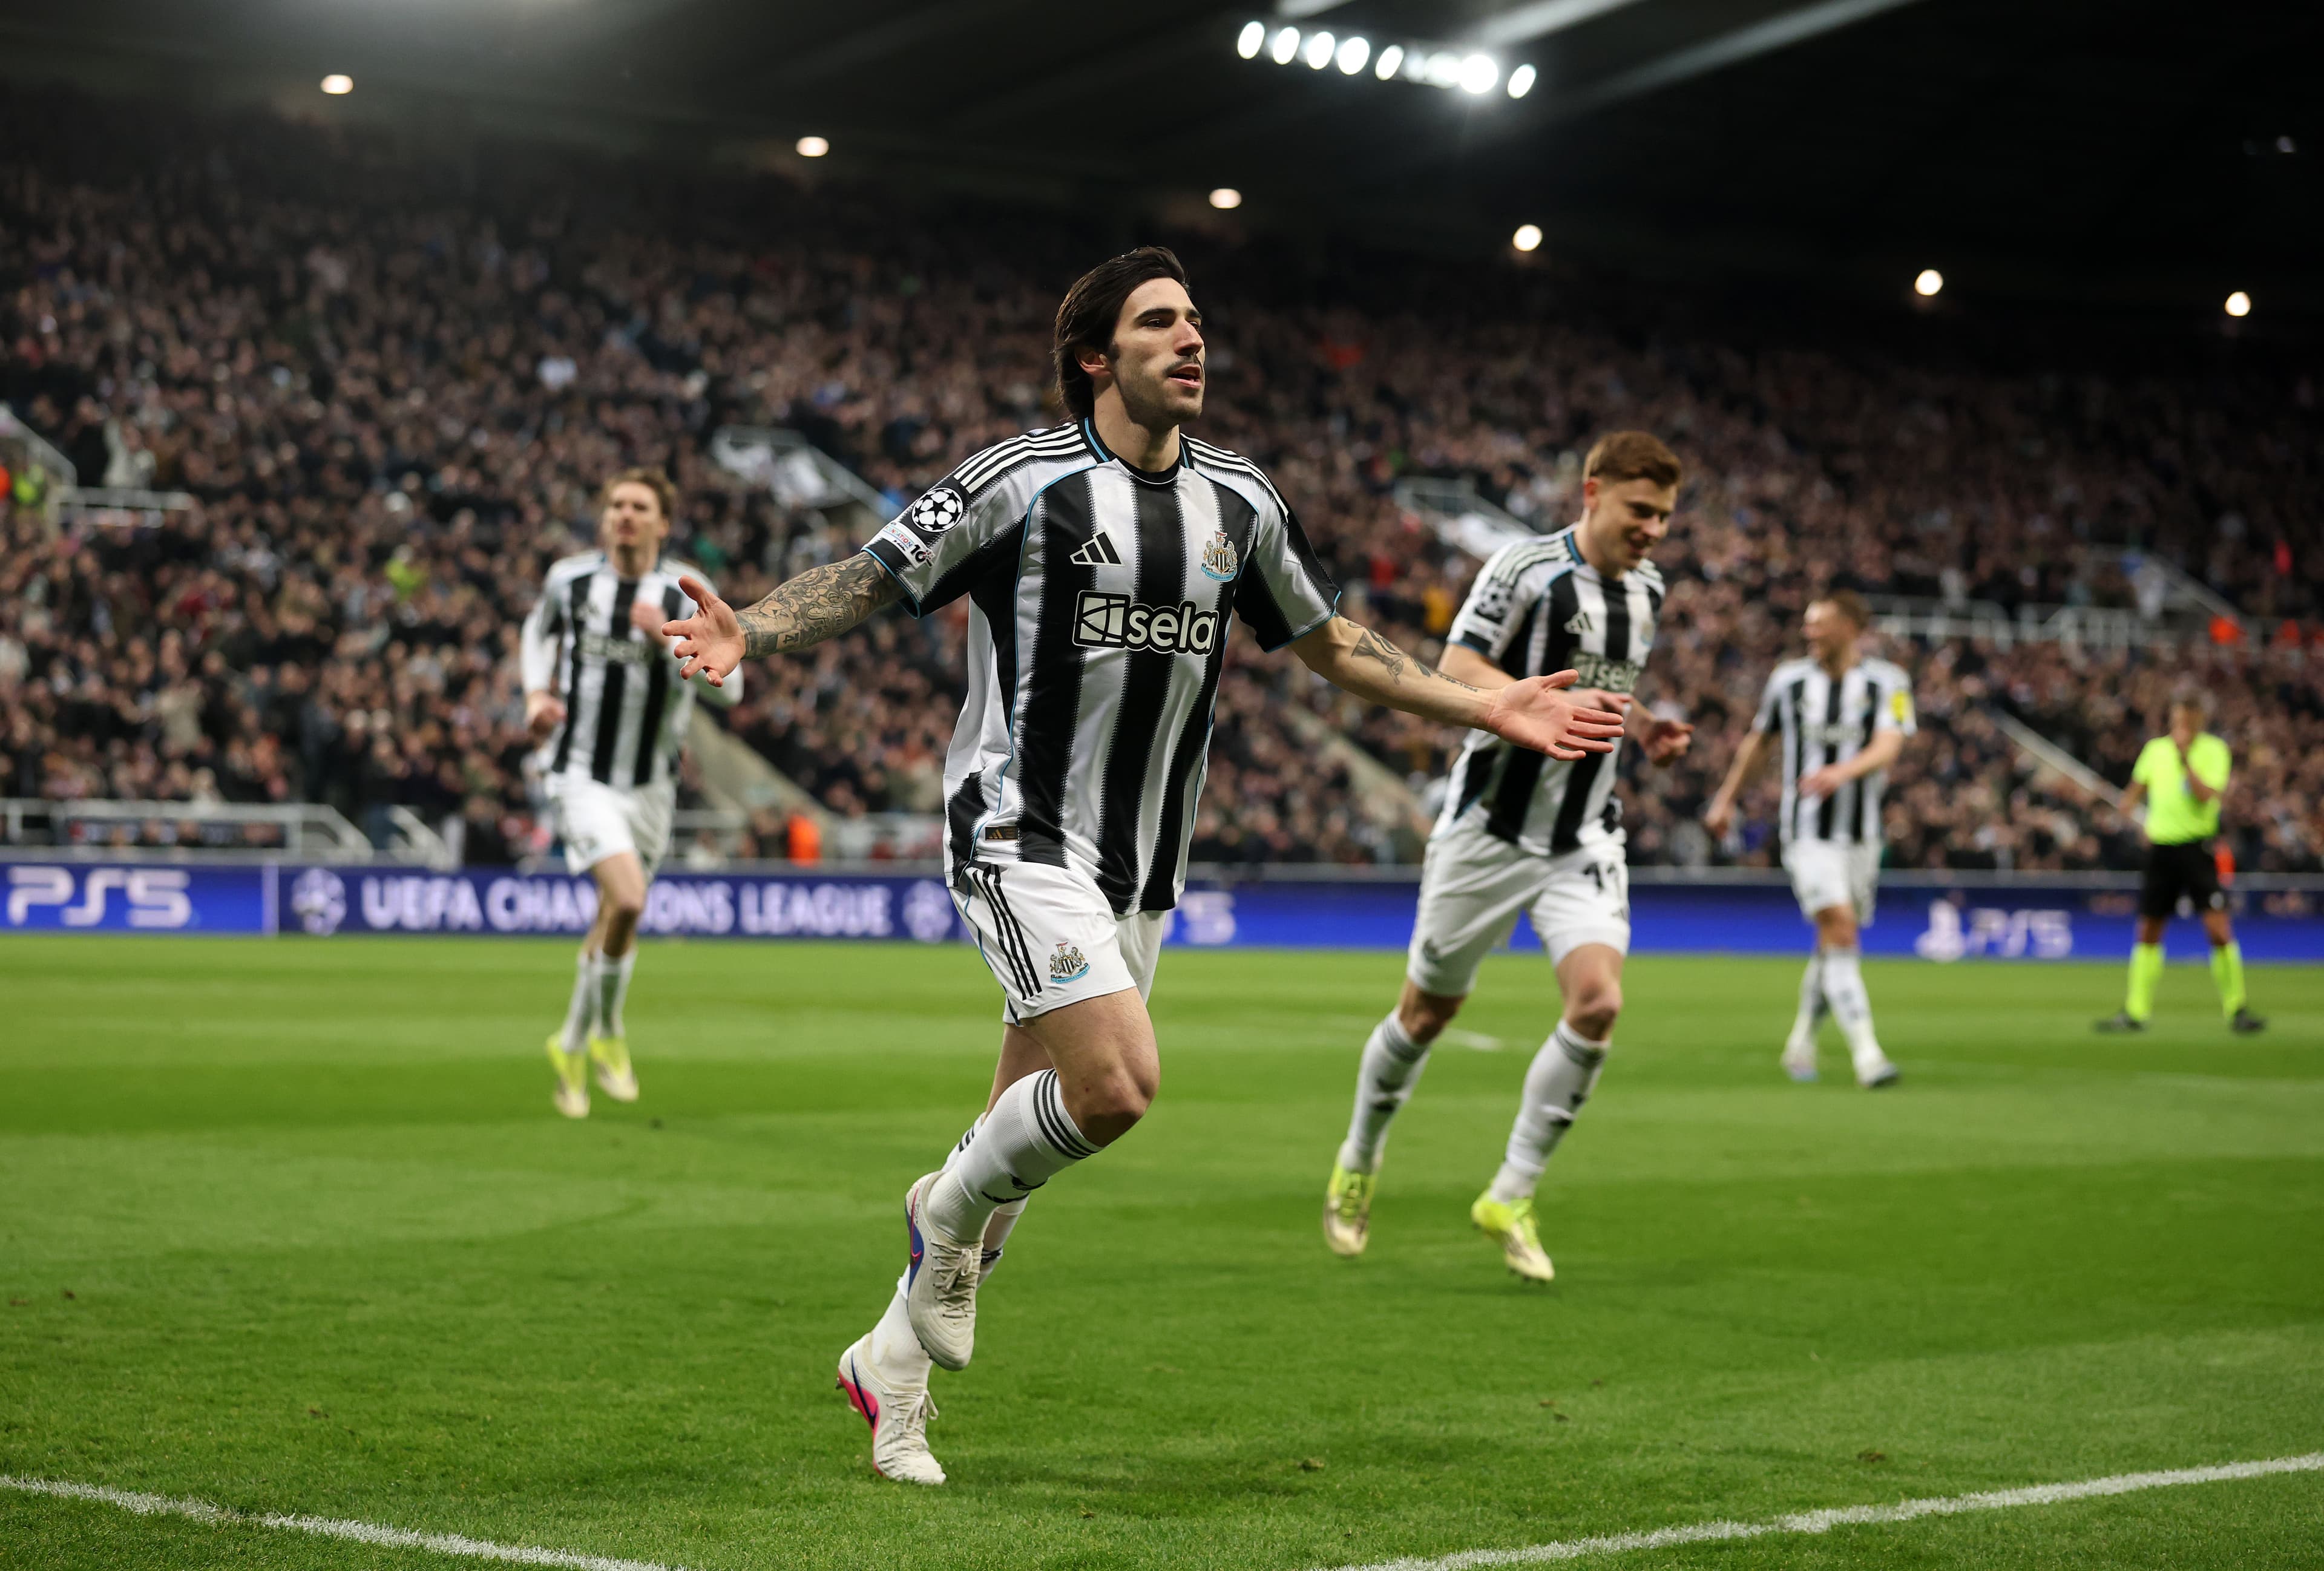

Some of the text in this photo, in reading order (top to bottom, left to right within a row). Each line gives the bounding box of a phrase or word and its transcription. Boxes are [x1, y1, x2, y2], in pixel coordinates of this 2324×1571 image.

[1127, 606, 1215, 650] sela
[8, 866, 192, 927] PS5
[362, 876, 484, 930] UEFA
[740, 882, 894, 936] LEAGUE
[1968, 908, 2072, 959] PS5
